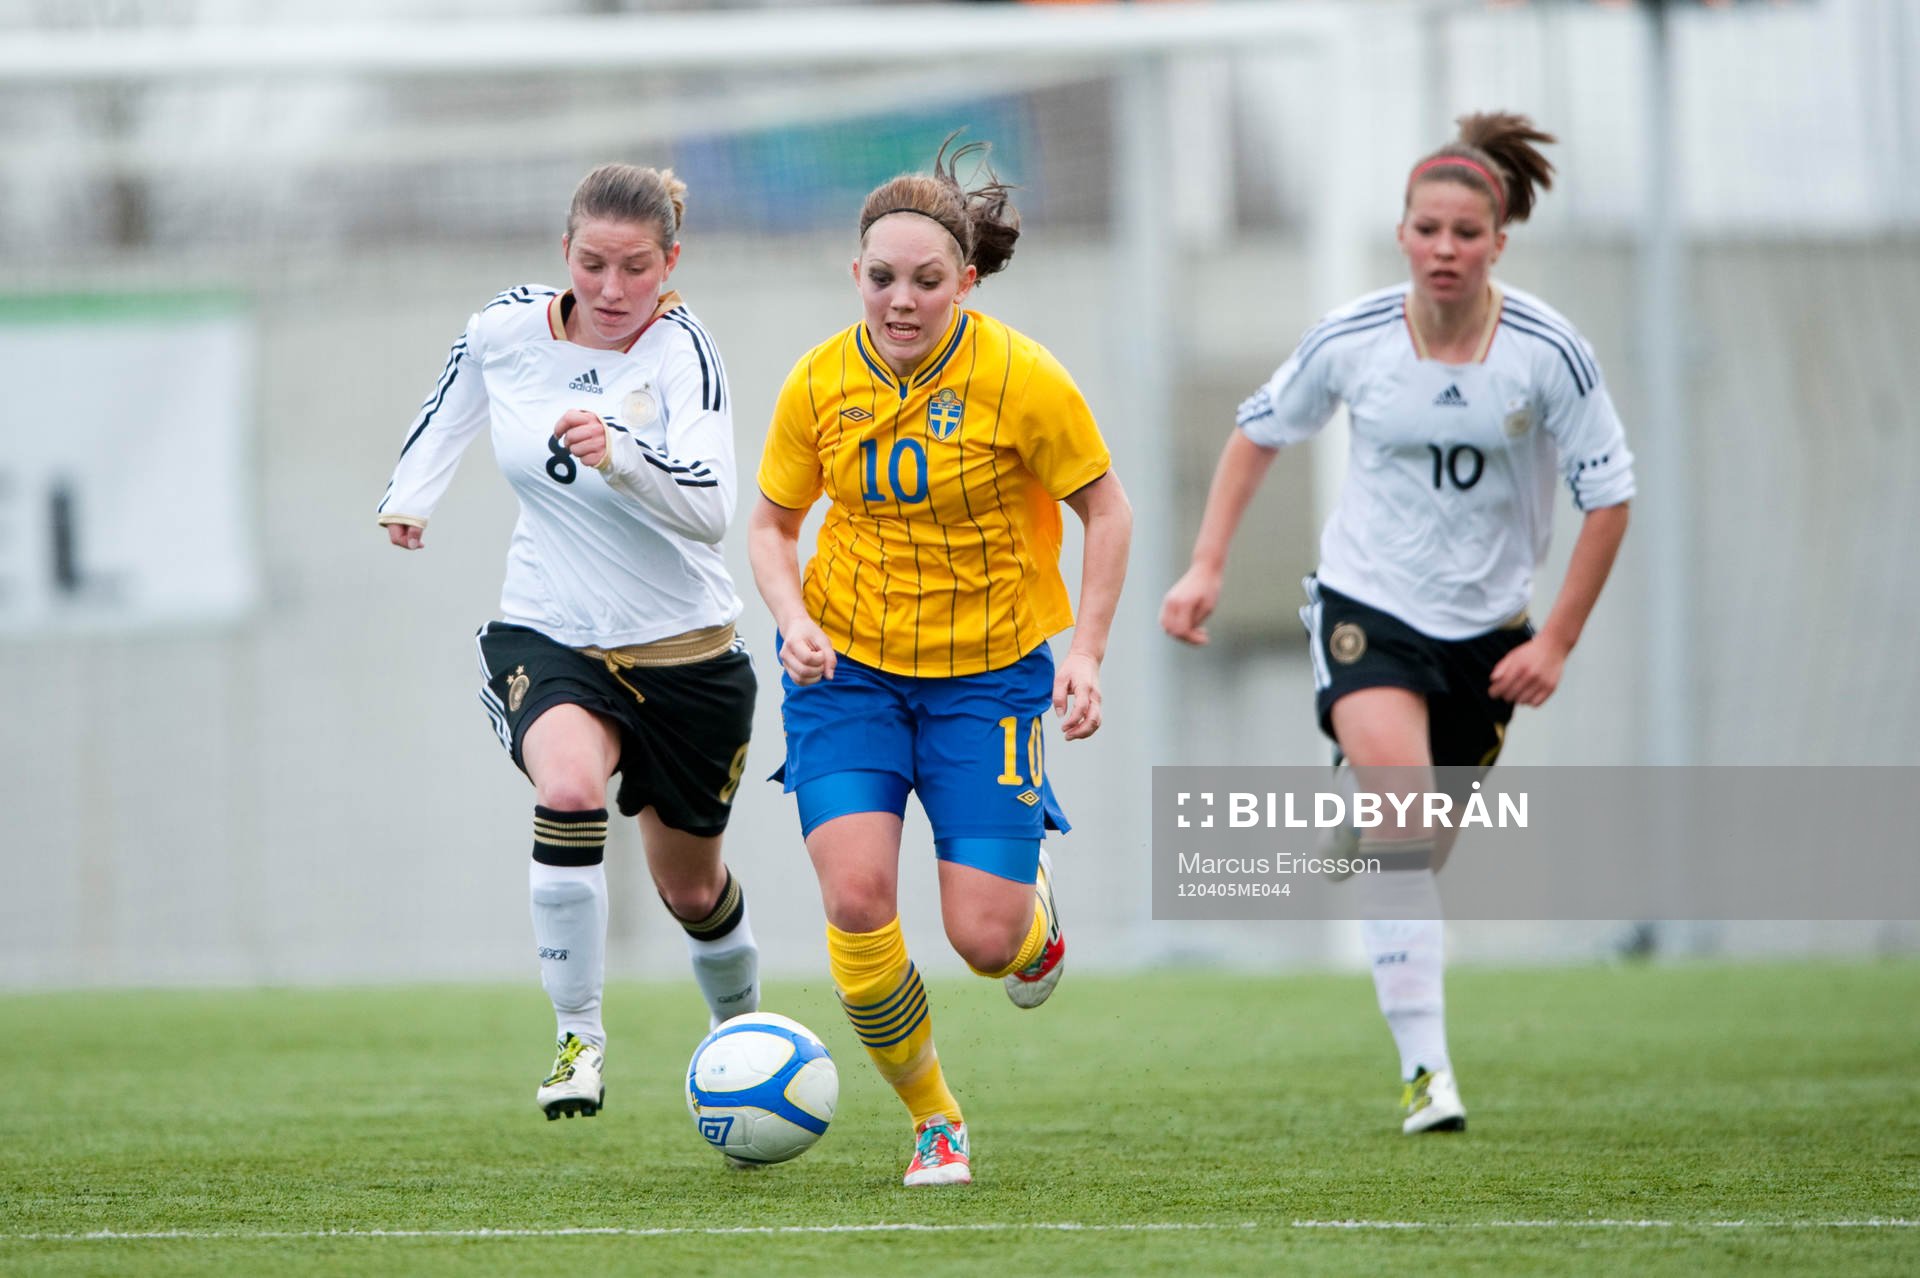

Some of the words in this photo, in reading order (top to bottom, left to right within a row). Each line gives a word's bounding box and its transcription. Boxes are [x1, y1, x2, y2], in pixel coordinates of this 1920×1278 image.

[568, 381, 604, 395] adidas
[546, 434, 577, 485] 8
[859, 437, 928, 504] 10
[1427, 443, 1485, 492] 10
[997, 716, 1043, 788] 10
